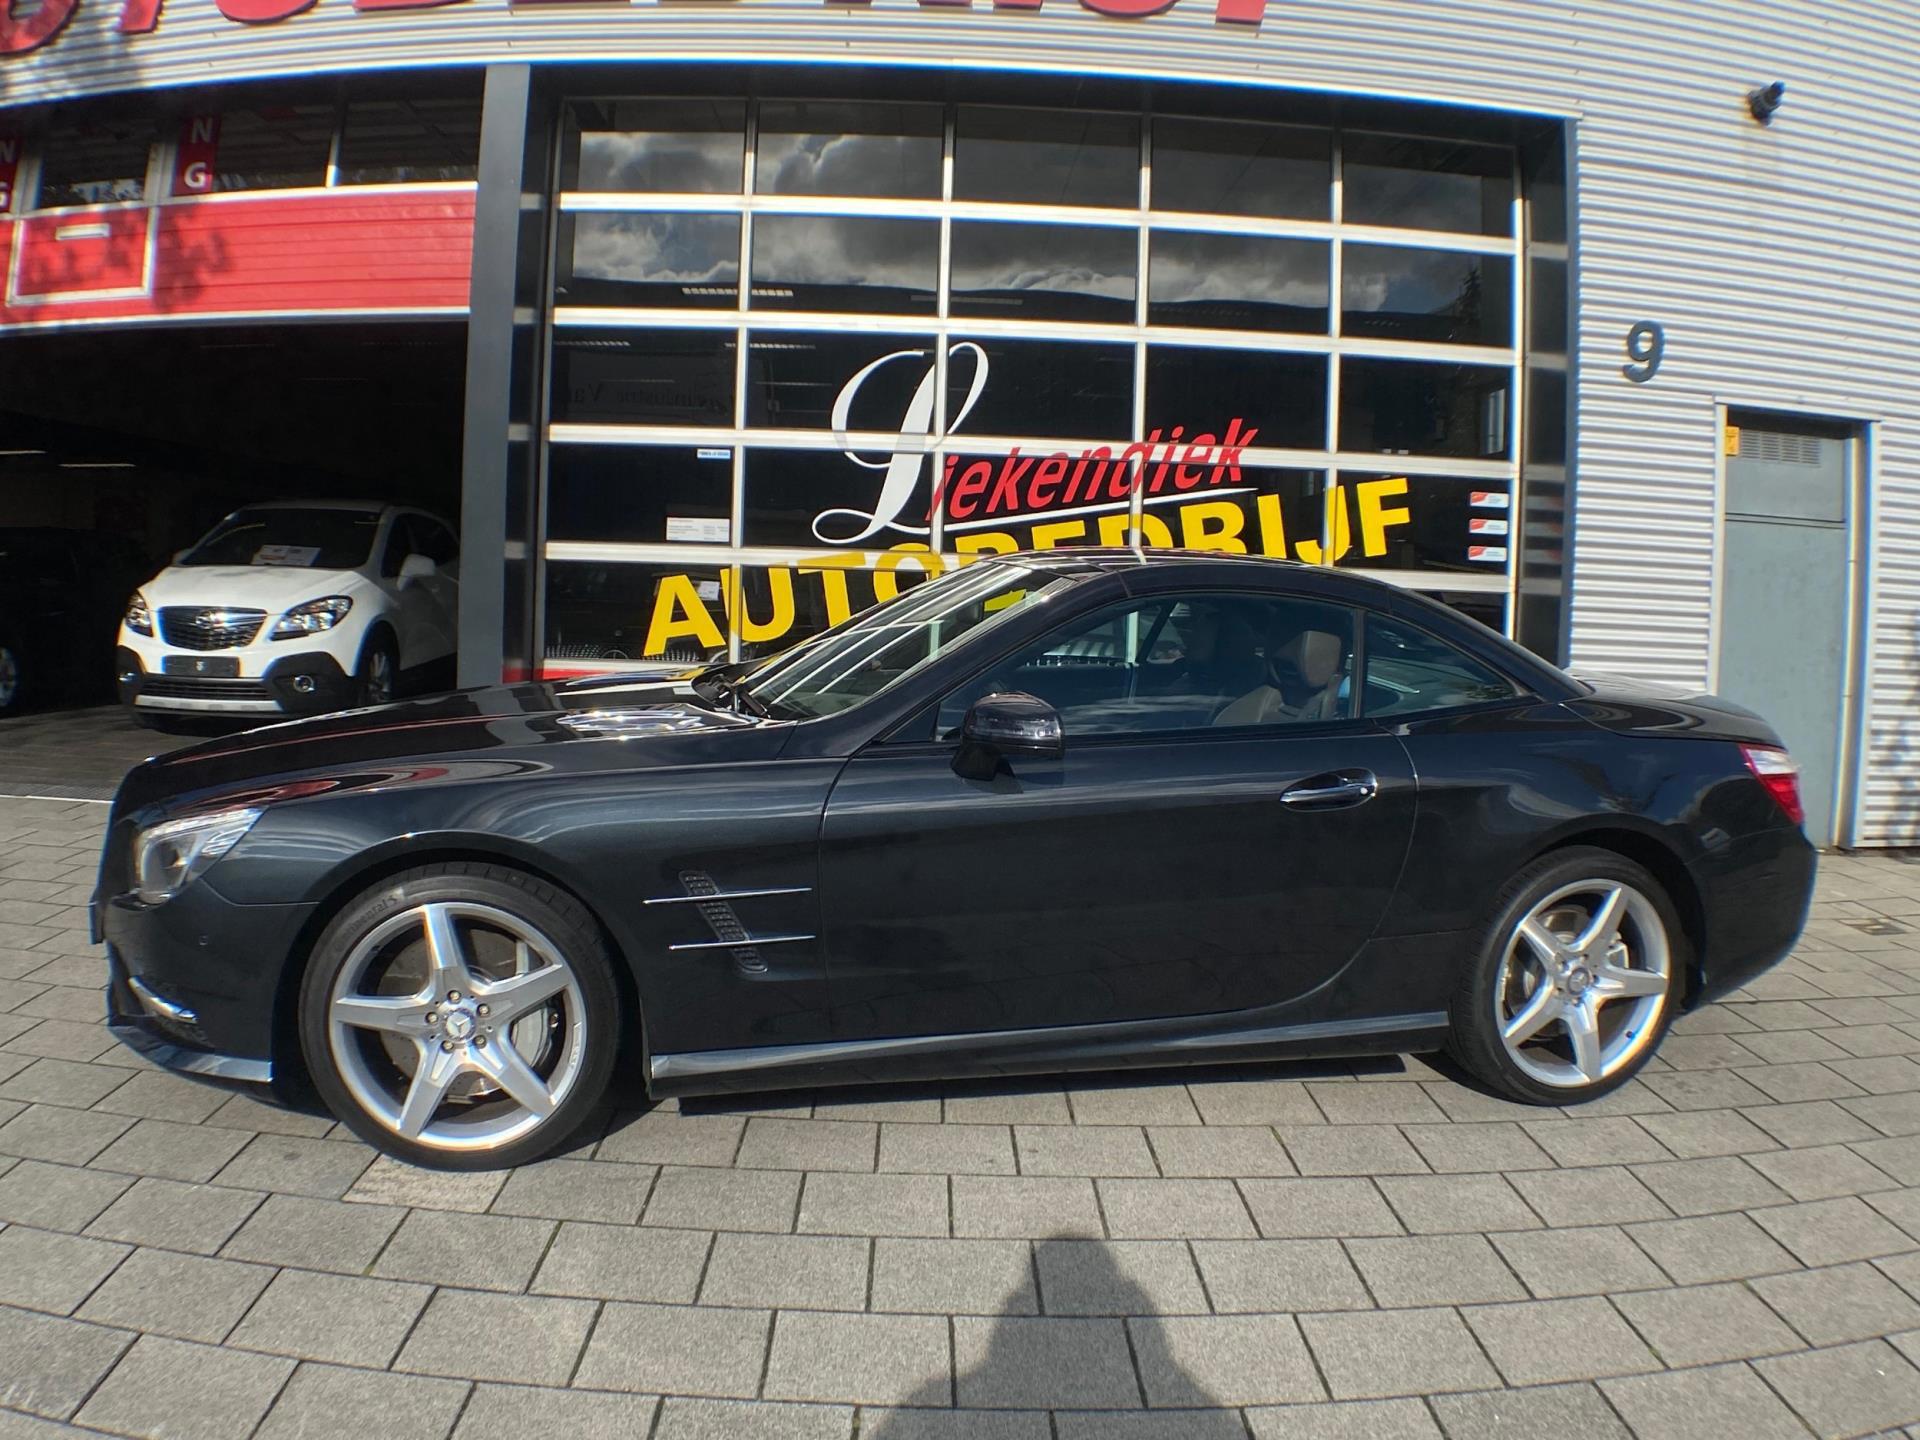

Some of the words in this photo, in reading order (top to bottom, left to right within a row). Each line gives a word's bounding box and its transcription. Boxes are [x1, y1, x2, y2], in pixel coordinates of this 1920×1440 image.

[1622, 320, 1665, 383] 9
[812, 341, 1258, 545] Liekendiek
[643, 478, 1410, 657] AUTORIJF
